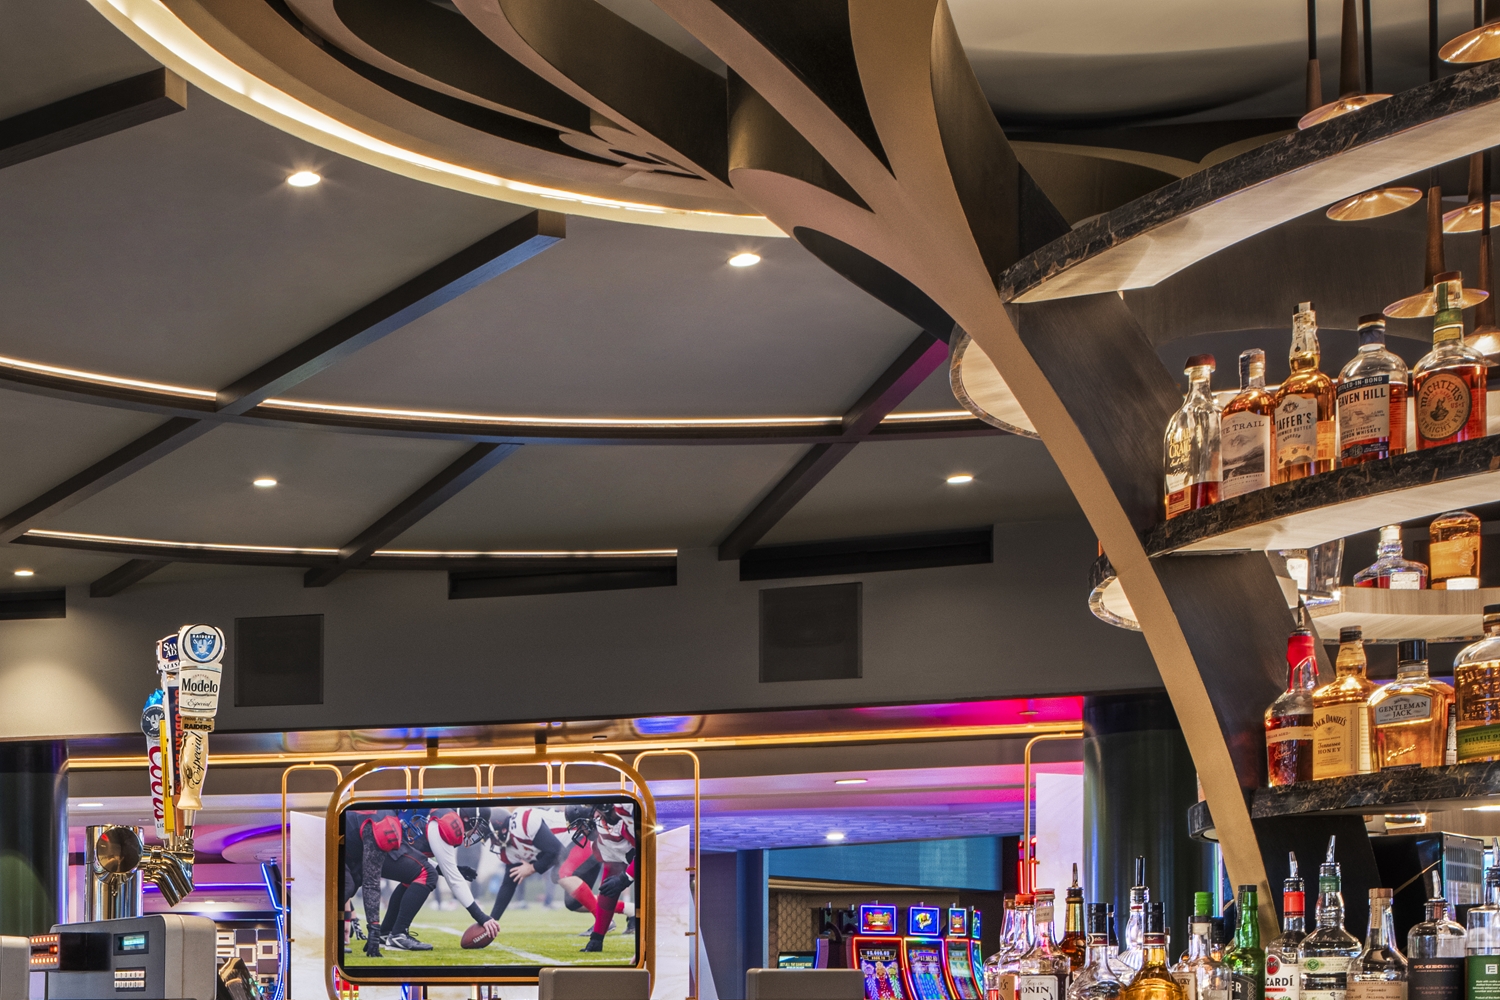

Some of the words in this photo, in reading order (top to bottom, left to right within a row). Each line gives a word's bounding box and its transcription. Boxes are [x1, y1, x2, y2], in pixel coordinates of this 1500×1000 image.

[1338, 392, 1360, 408] EAVEN
[1363, 388, 1386, 400] HILL
[1421, 380, 1463, 408] MICHTER'S
[1452, 409, 1463, 423] RYE
[1232, 420, 1264, 431] TRAIL
[1356, 428, 1381, 436] WHISKEY
[1421, 418, 1451, 434] STRAIGHT
[1169, 440, 1191, 459] CRAIG
[181, 678, 218, 693] Modelo
[1378, 701, 1427, 713] GENTLEMAN
[1393, 709, 1412, 718] JACK
[183, 723, 212, 731] RAIDERS
[1313, 718, 1327, 730] JACK
[1326, 714, 1347, 726] DANIEL'S
[149, 745, 165, 822] Coors
[1265, 975, 1294, 987] CARDÍ
[1023, 986, 1050, 994] ONIN
